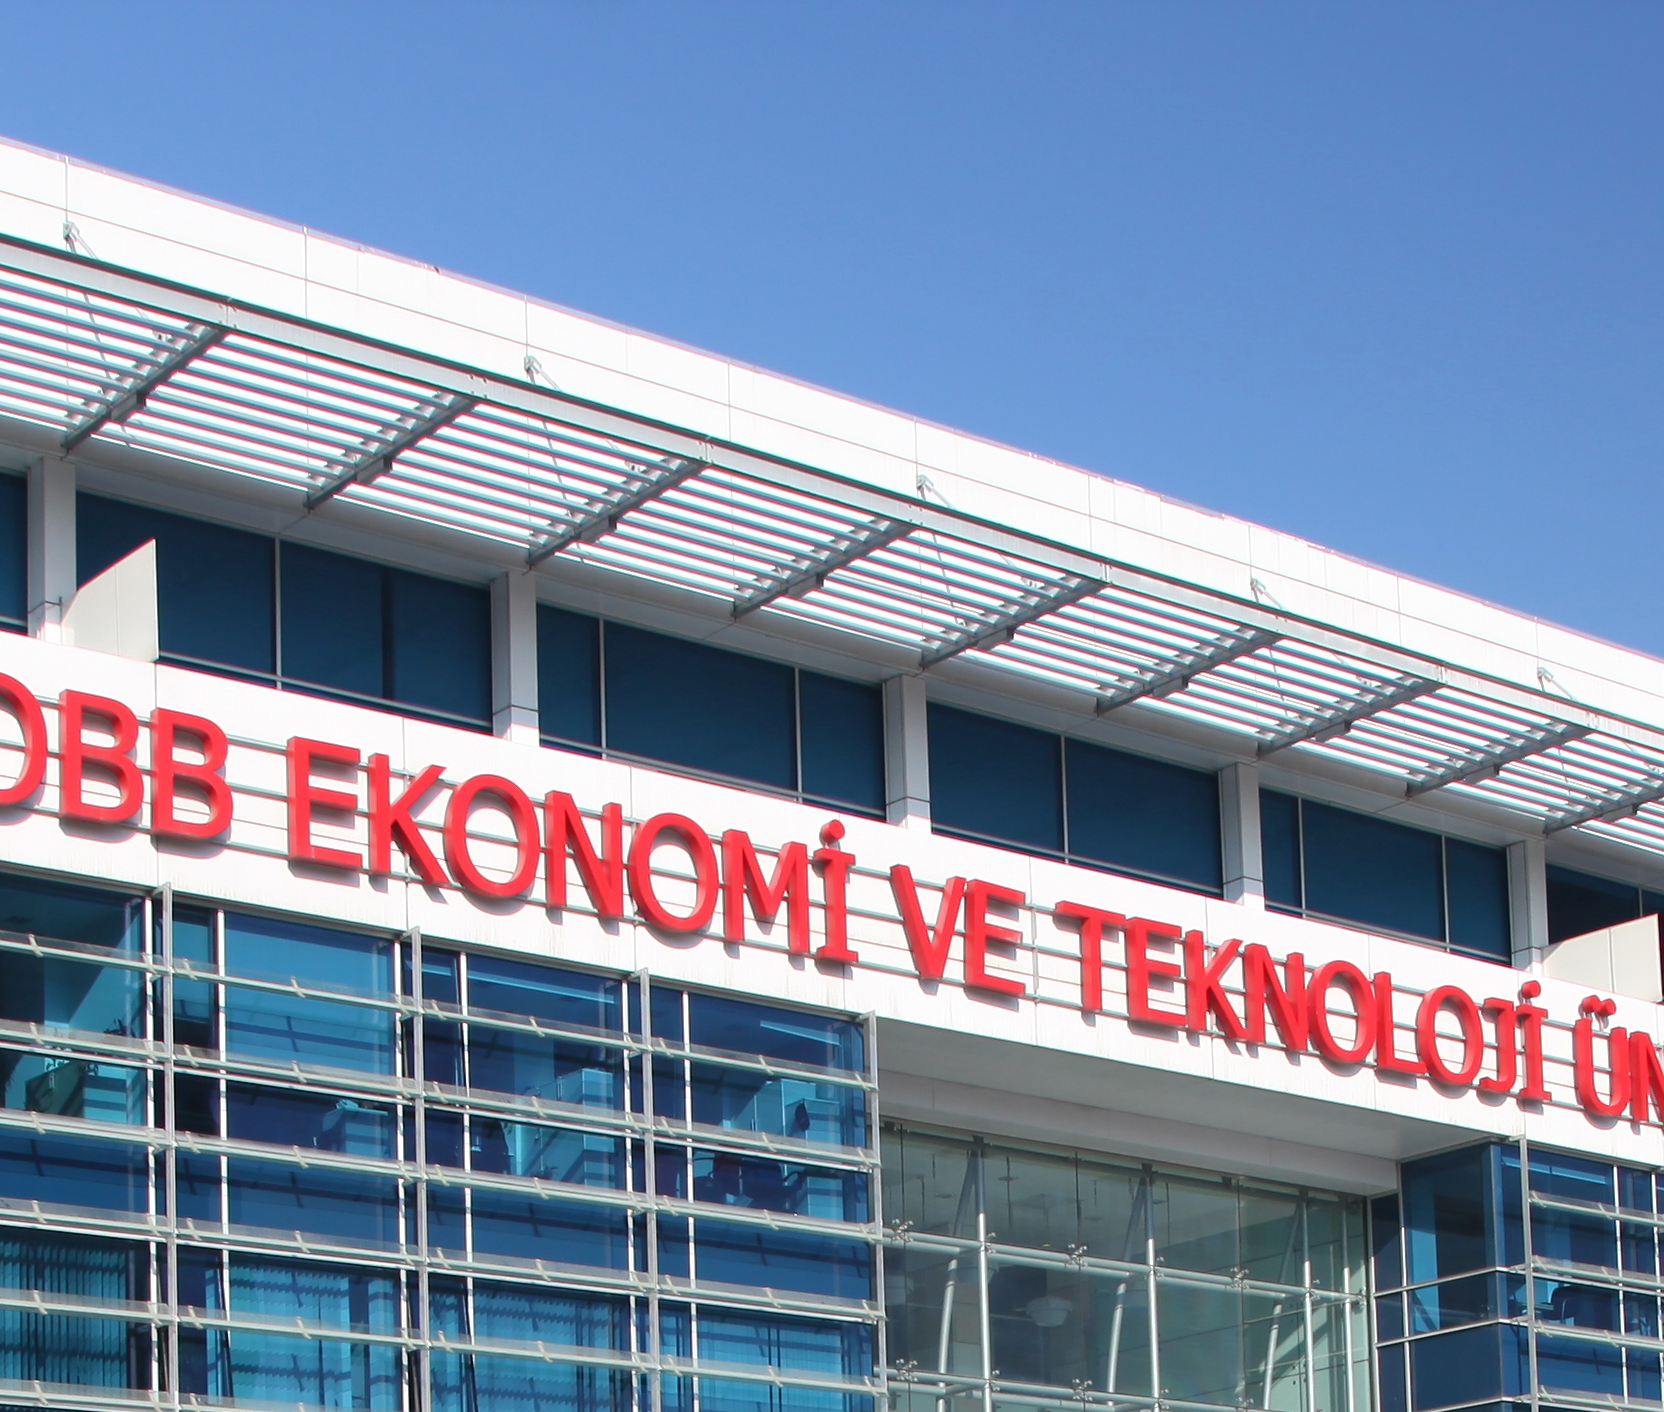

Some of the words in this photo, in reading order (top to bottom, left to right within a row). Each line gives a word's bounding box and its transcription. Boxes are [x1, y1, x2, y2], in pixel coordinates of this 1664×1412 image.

[284, 736, 858, 966] EKONOMİ
[889, 863, 1029, 1000] VE
[1055, 899, 1552, 1107] TEKNOLOJİ
